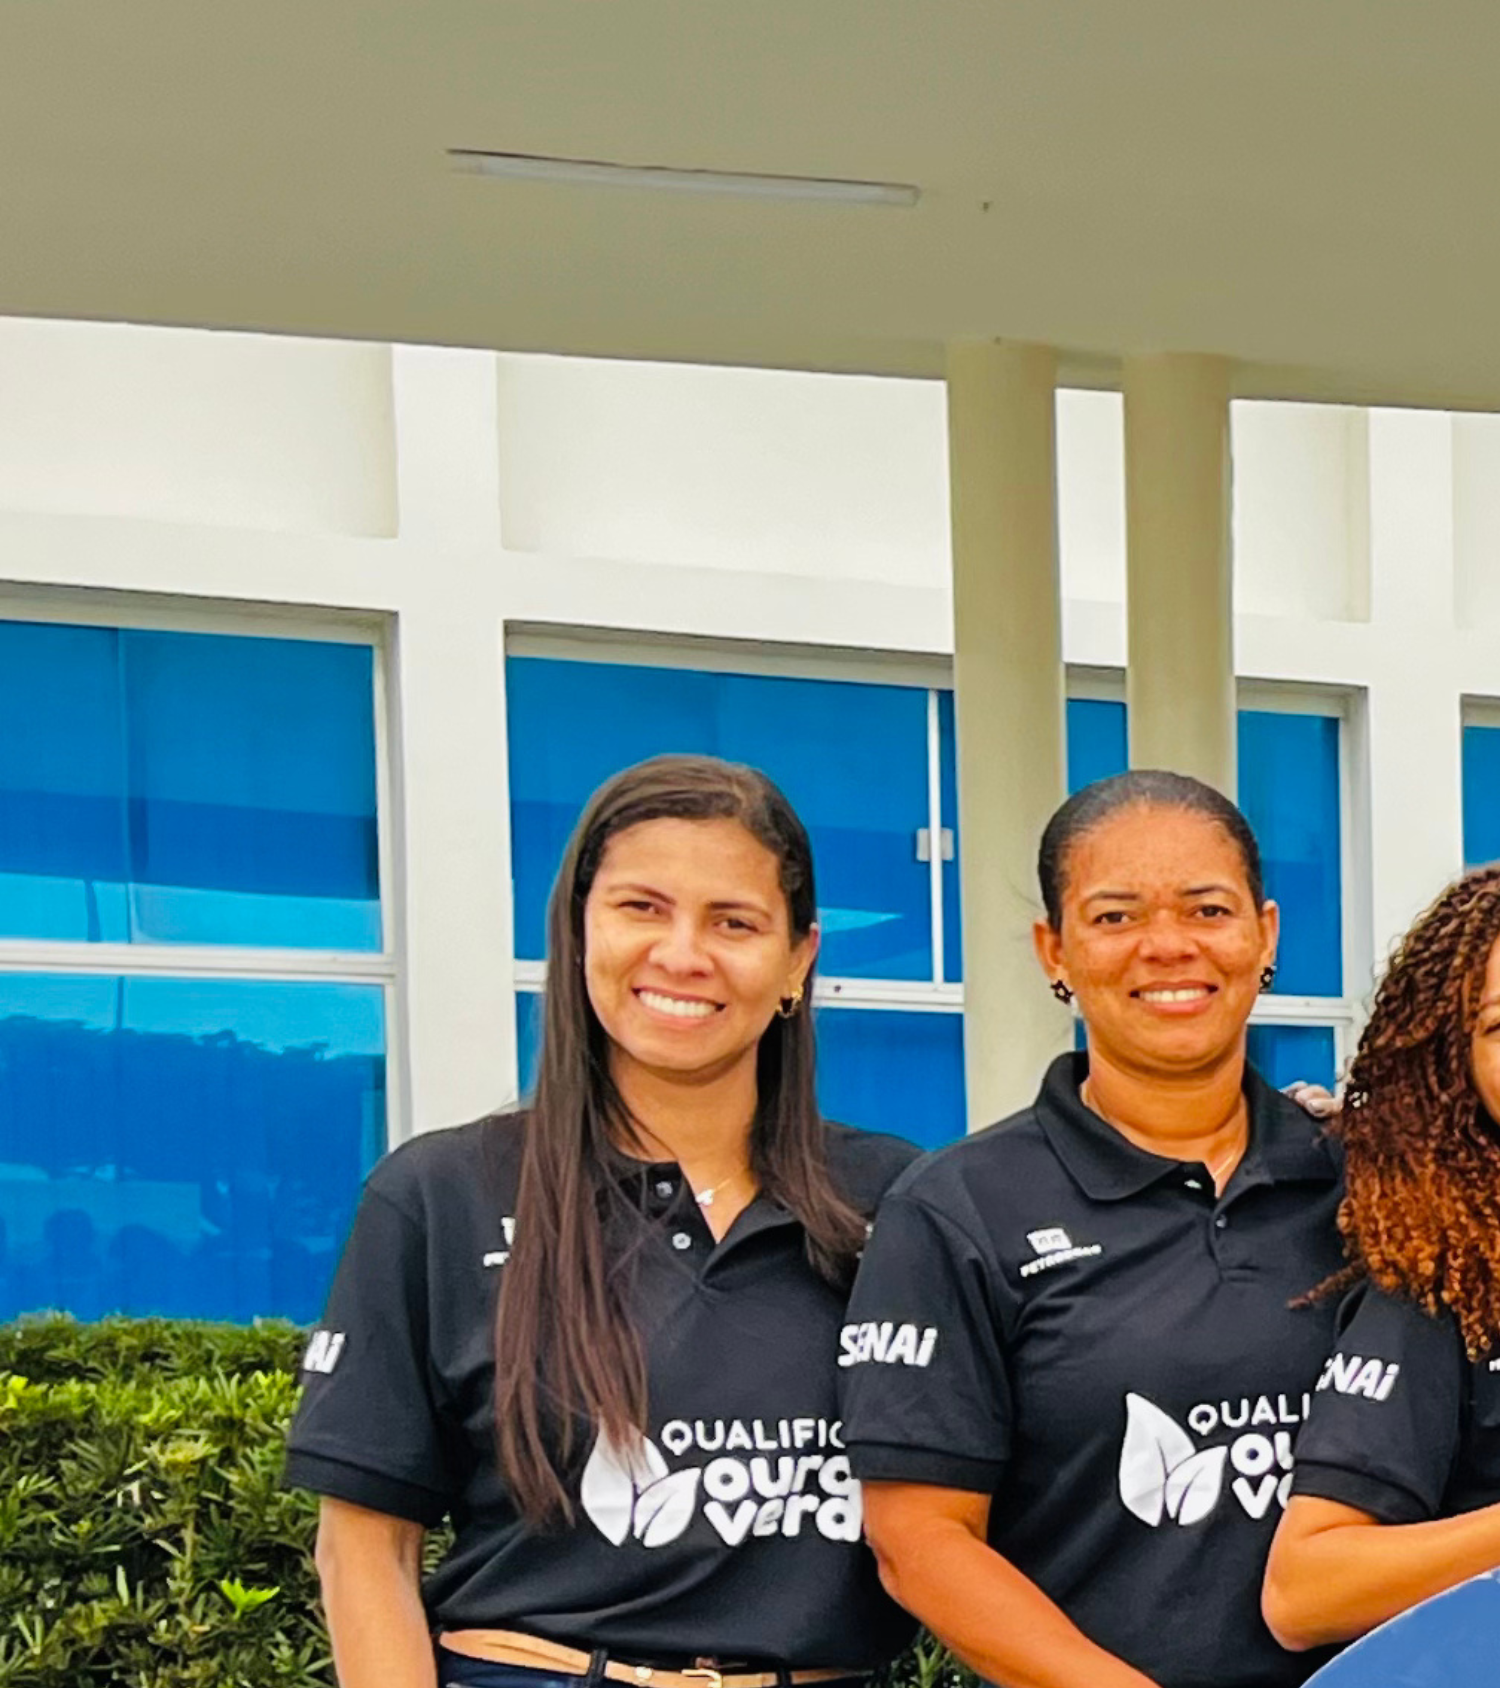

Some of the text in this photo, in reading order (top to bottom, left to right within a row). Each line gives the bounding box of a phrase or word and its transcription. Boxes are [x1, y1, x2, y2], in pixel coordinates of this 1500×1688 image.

[659, 1416, 848, 1458] QUALIFIC
[1186, 1391, 1312, 1437] QUALI
[702, 1480, 864, 1548] verd
